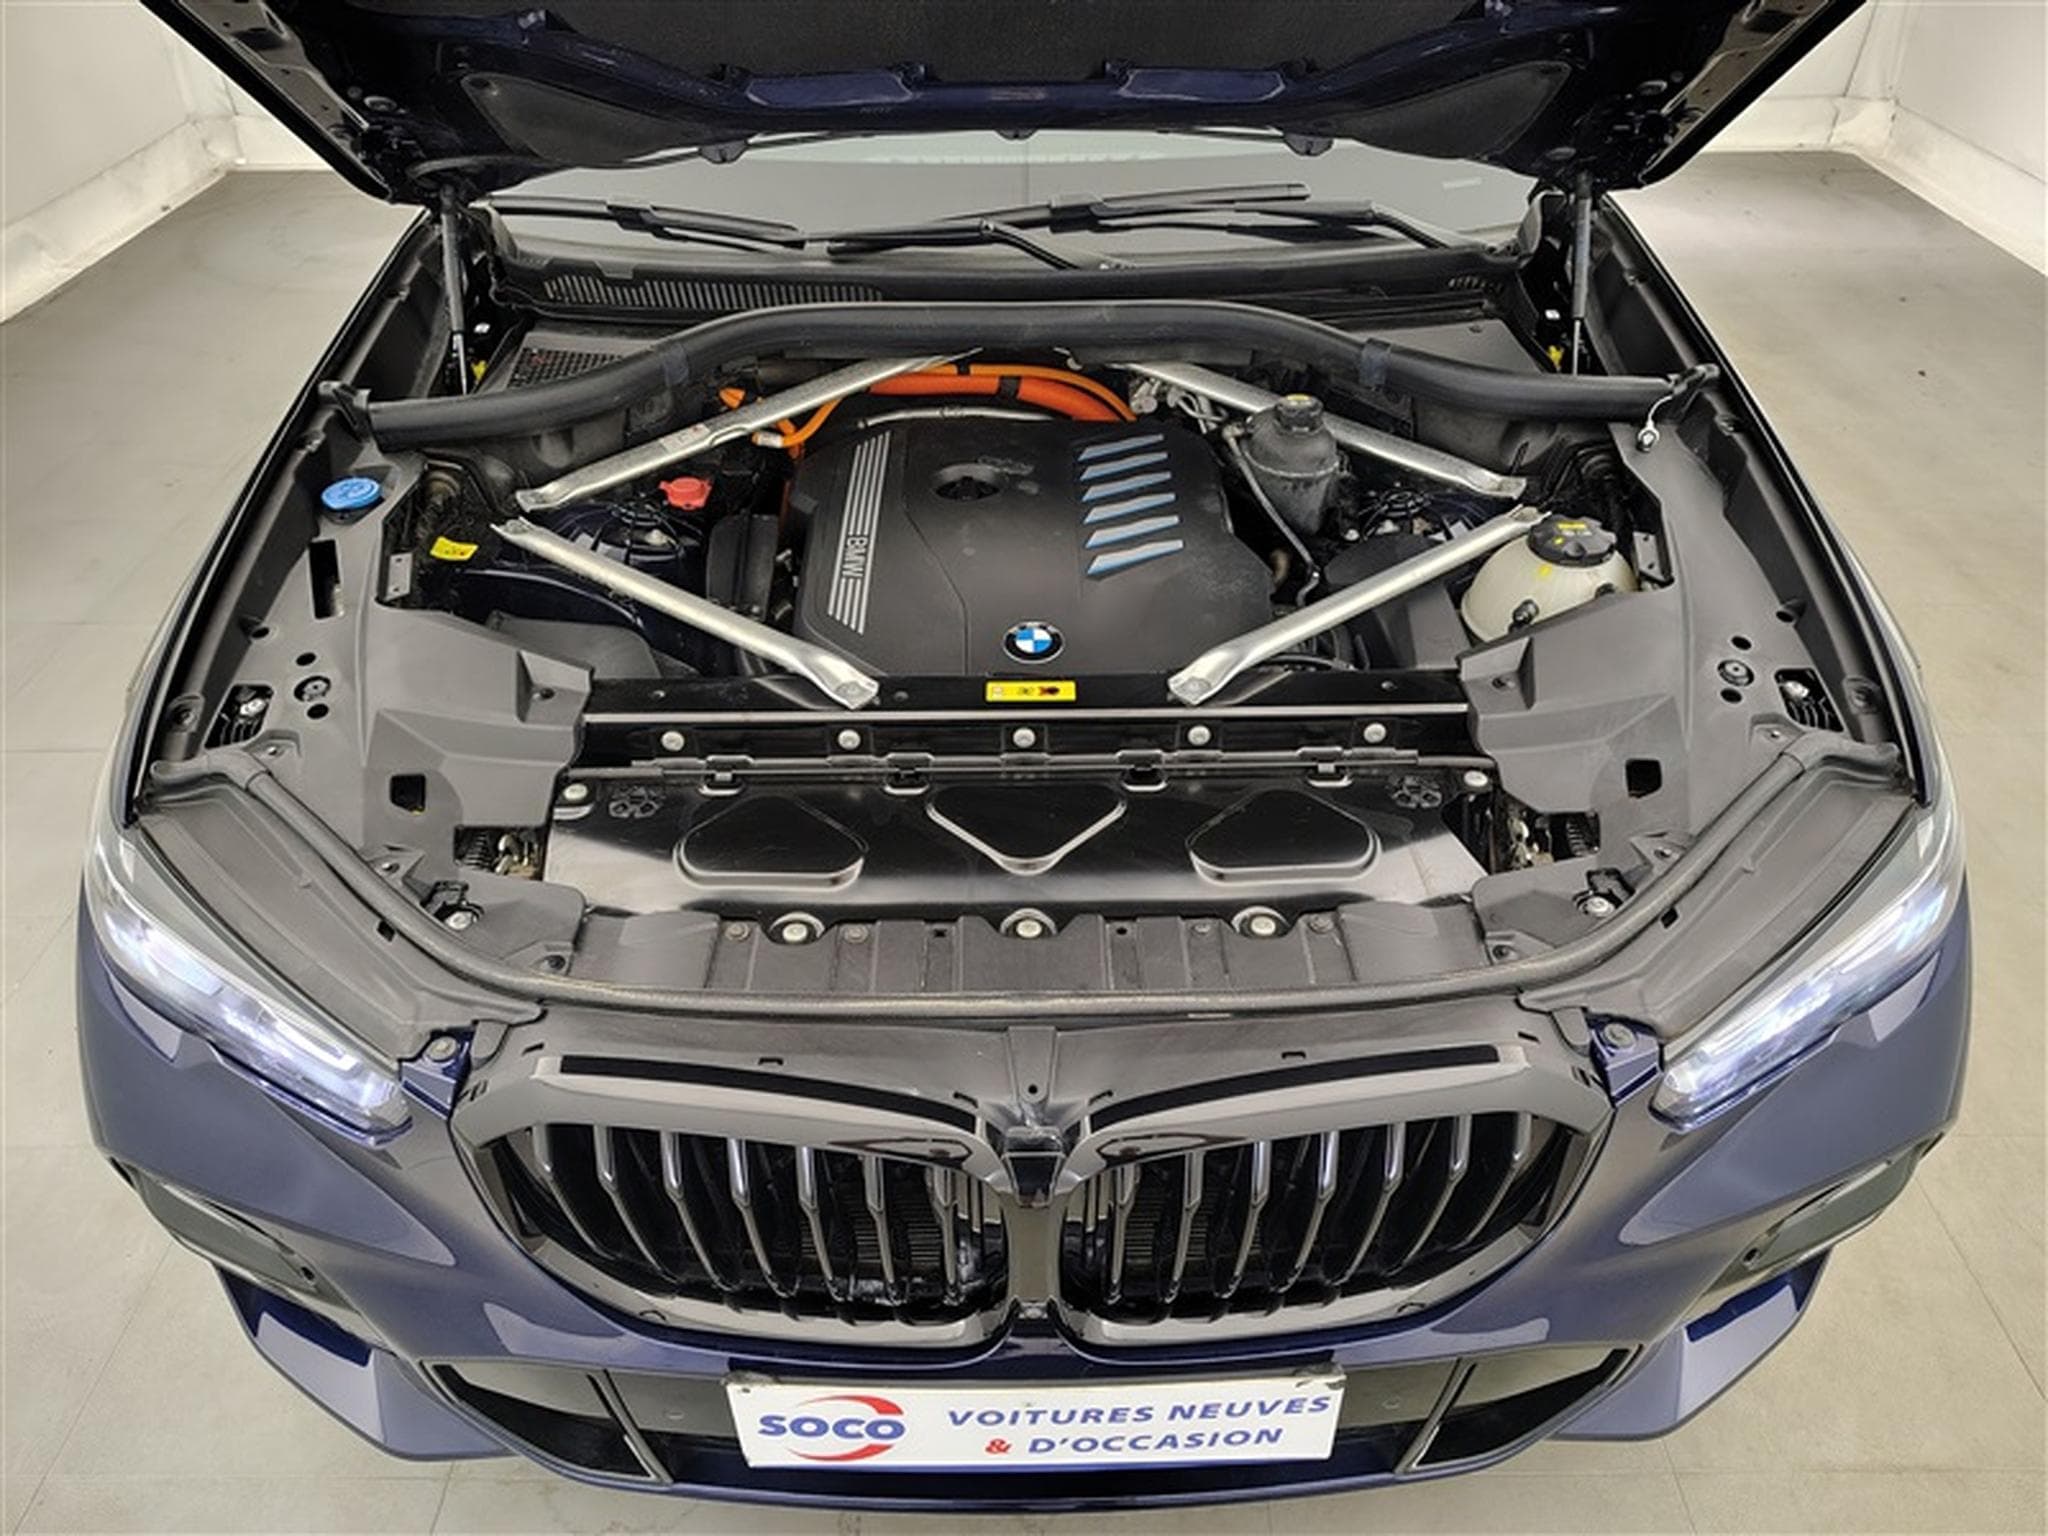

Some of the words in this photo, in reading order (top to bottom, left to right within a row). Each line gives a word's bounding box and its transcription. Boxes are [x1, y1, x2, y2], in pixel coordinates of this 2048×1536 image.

[842, 536, 869, 577] BMW
[947, 1406, 1155, 1428] VOITURES
[1167, 1395, 1332, 1421] NEUVES
[758, 1414, 905, 1440] SOCO
[984, 1438, 1012, 1455] &
[1027, 1427, 1285, 1455] D'OCCASION
